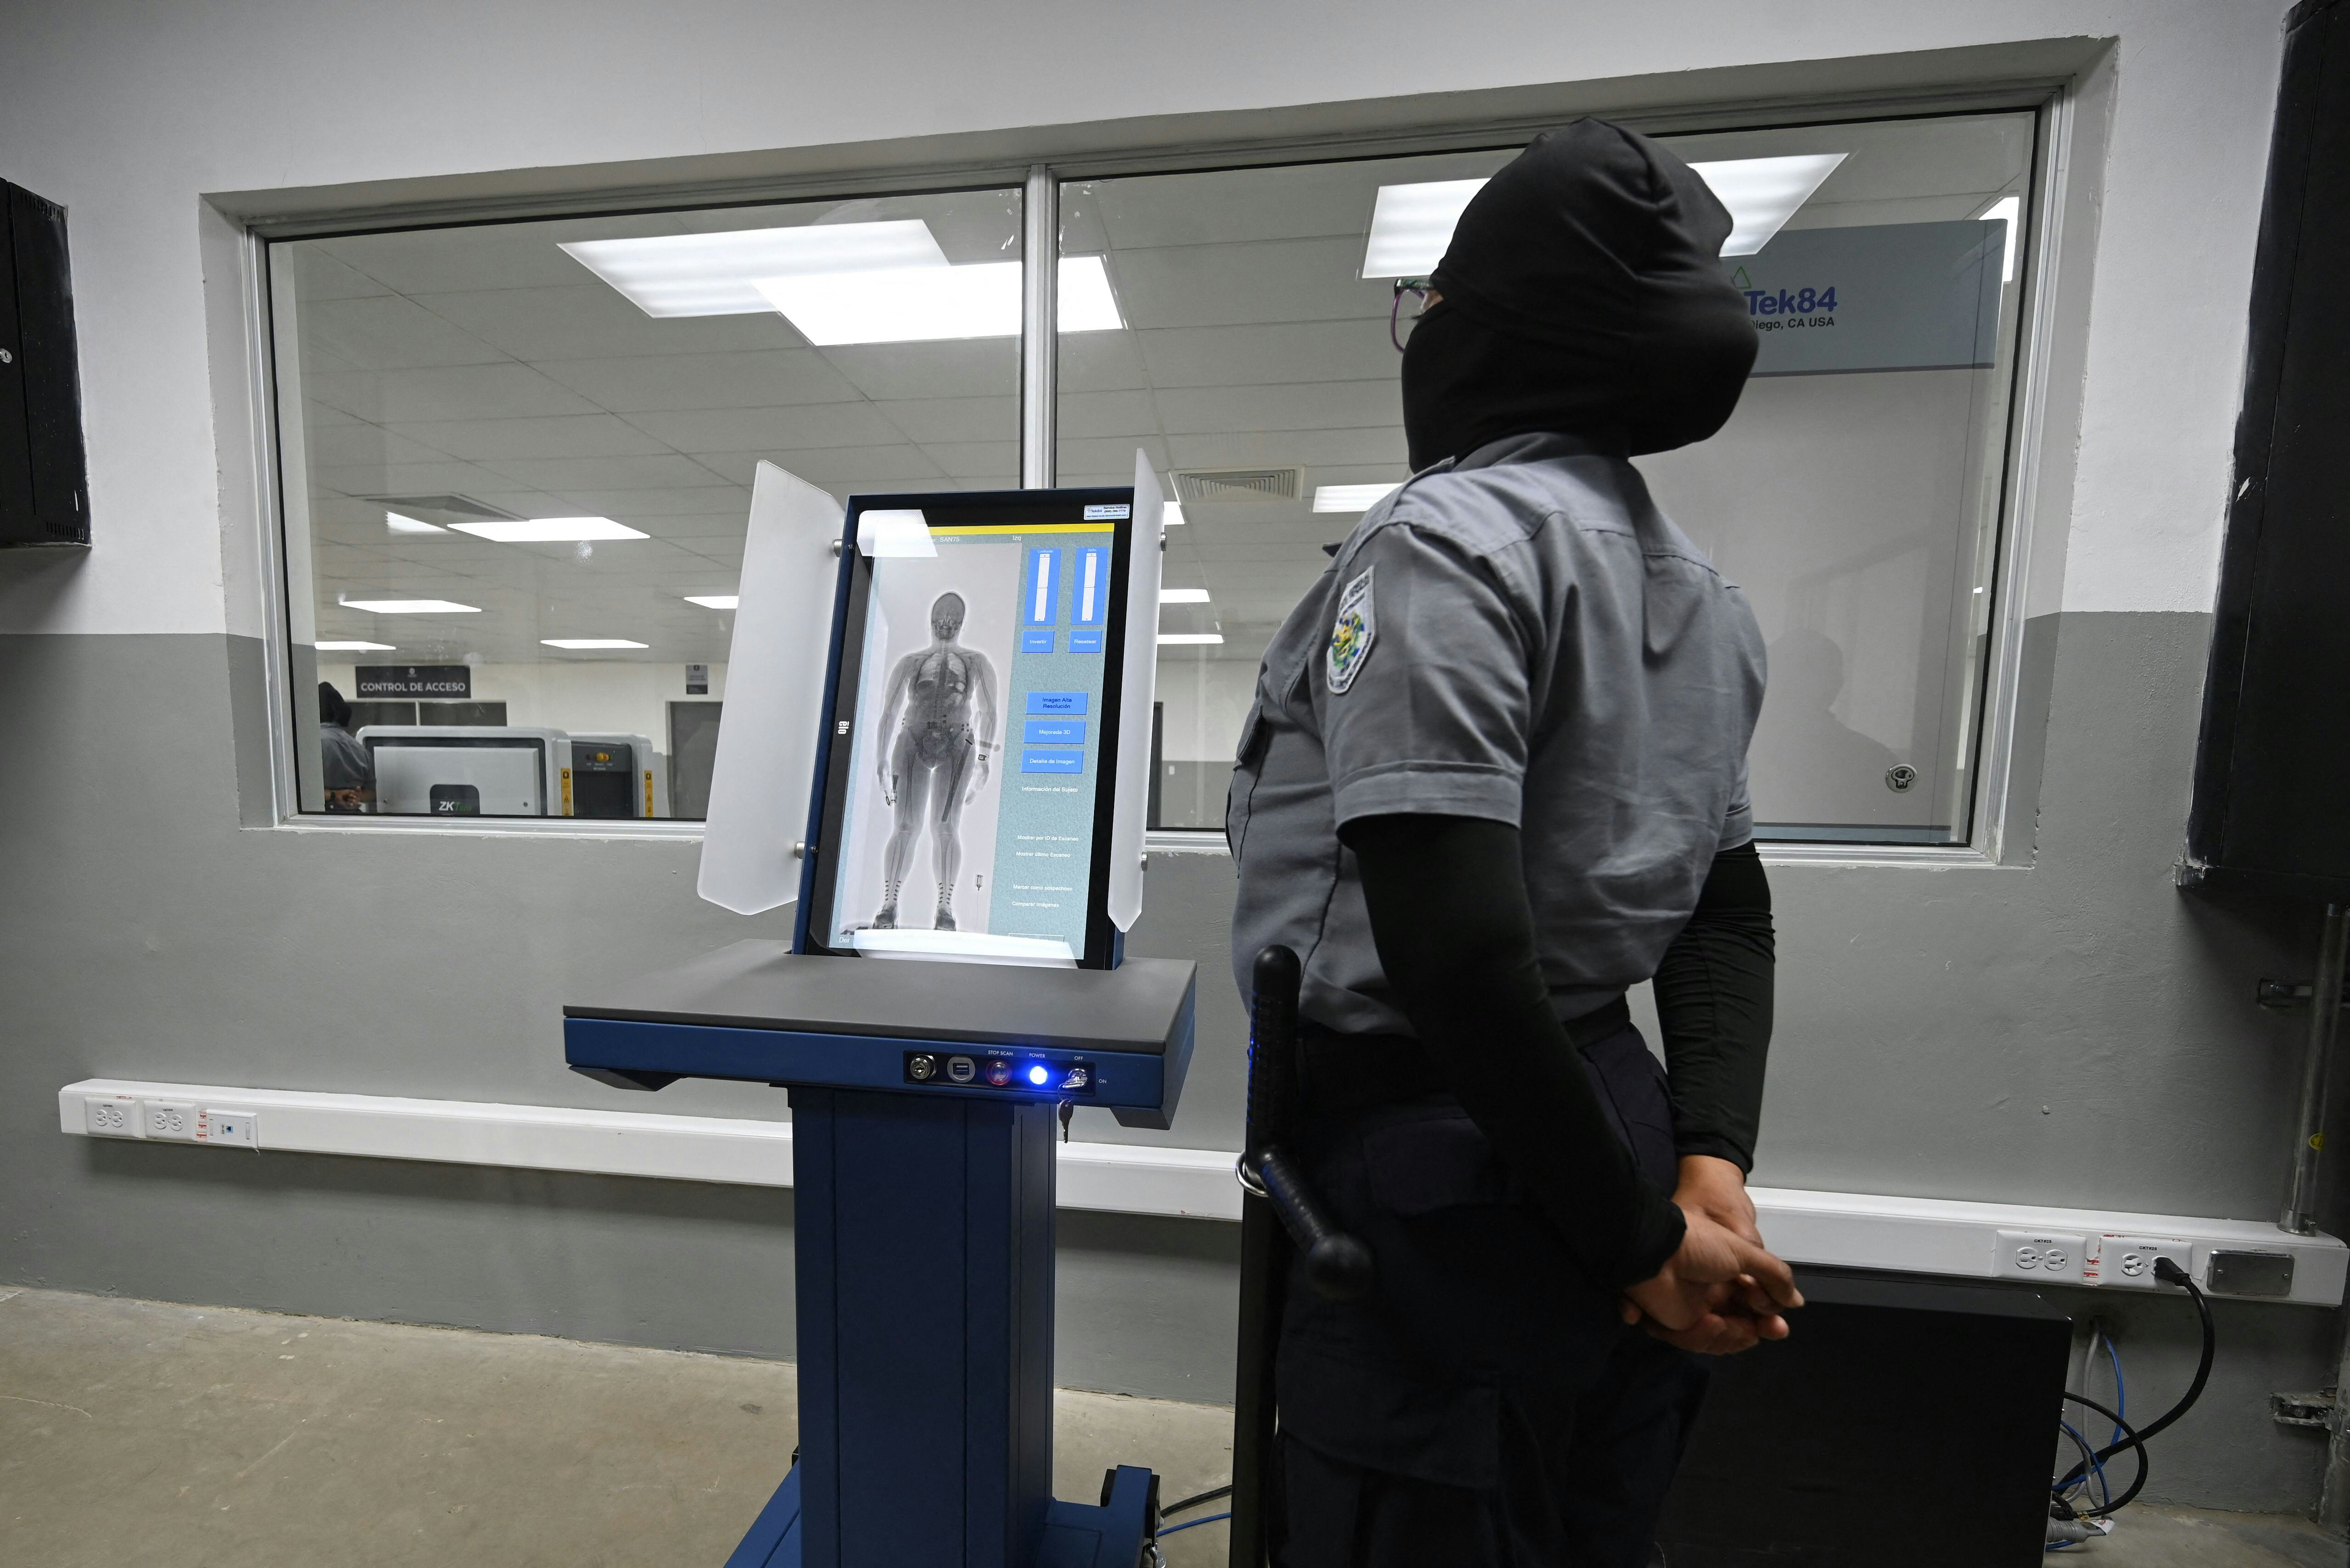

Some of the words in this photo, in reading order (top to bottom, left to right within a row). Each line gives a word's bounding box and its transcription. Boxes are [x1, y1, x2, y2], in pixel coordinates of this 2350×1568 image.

[1744, 286, 1837, 315] Tek84
[1787, 318, 1805, 328] CA
[1809, 317, 1835, 327] USA
[360, 682, 408, 692] CONTROL
[410, 682, 424, 692] DE
[425, 682, 466, 692] ACCESO
